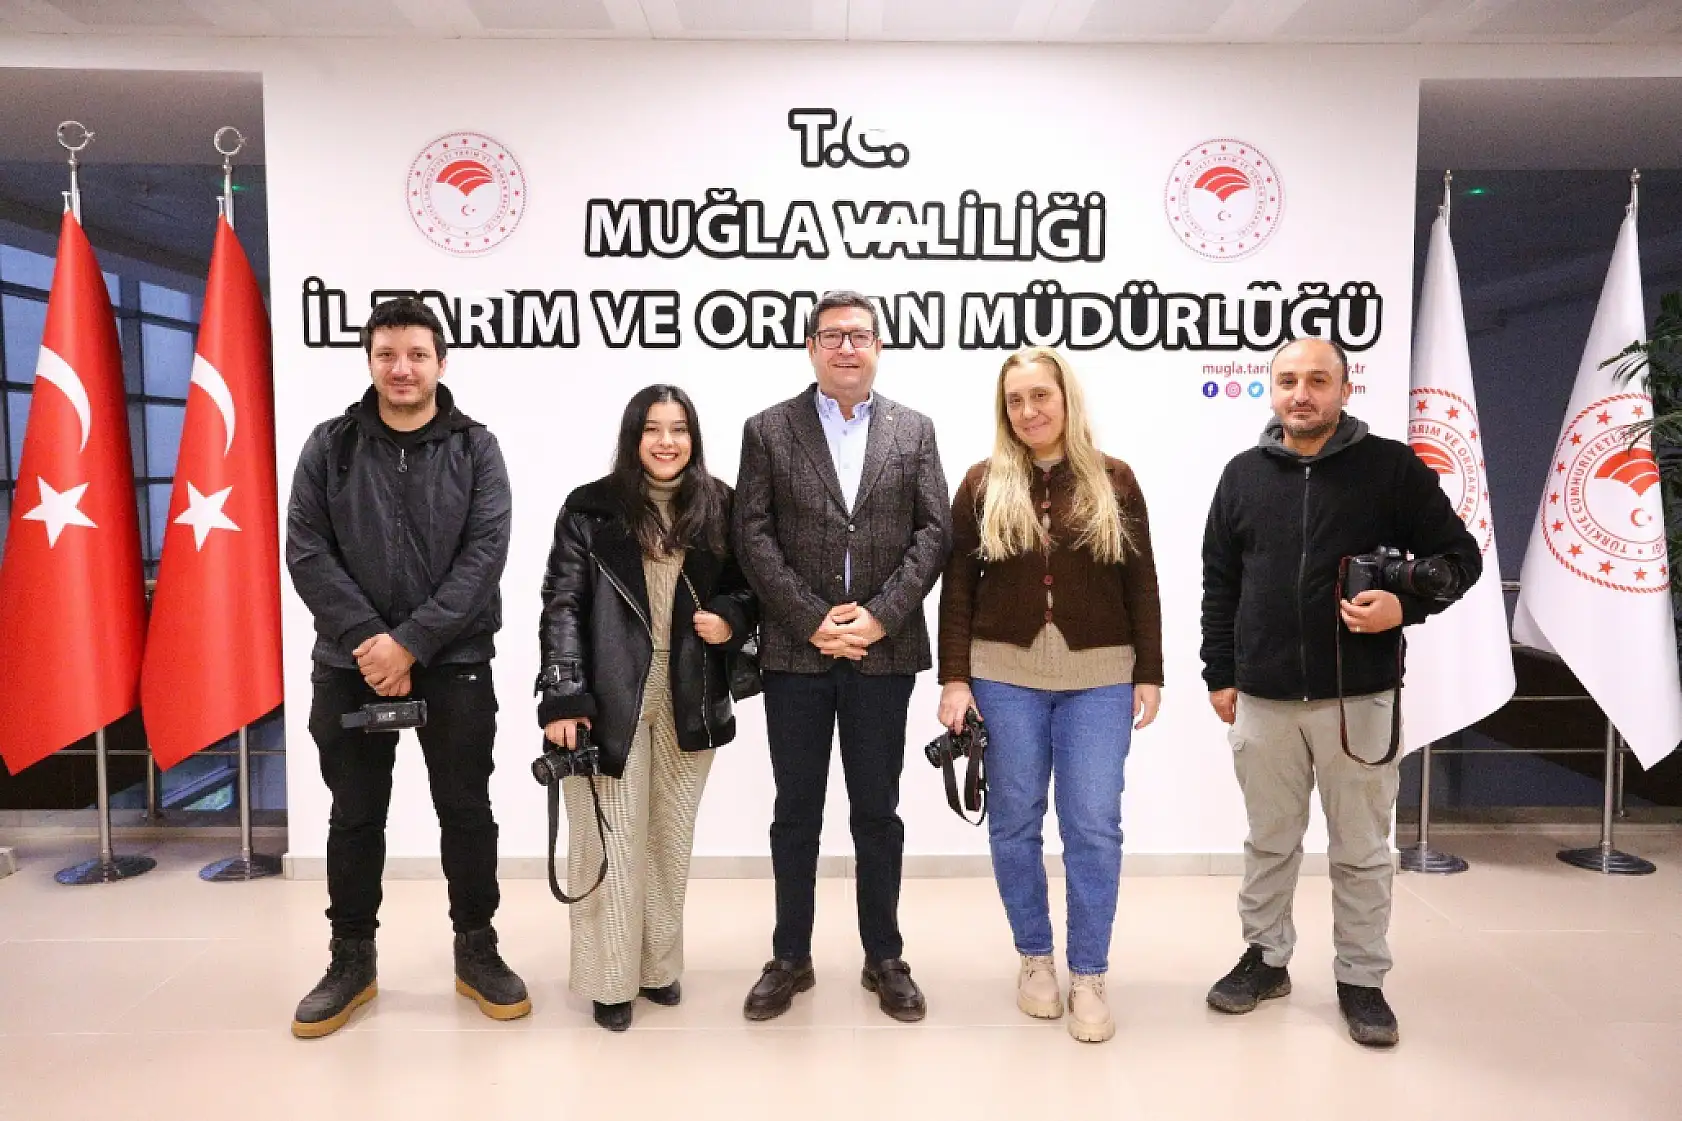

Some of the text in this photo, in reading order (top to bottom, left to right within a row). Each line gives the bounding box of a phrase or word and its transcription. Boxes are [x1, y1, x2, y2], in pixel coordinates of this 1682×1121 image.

[585, 188, 829, 260] MUĞLA
[832, 190, 1105, 263] VALİLİĞİ
[302, 276, 367, 348] İL
[590, 291, 680, 348] VE
[959, 280, 1383, 352] MÜDÜRLÜĞÜ
